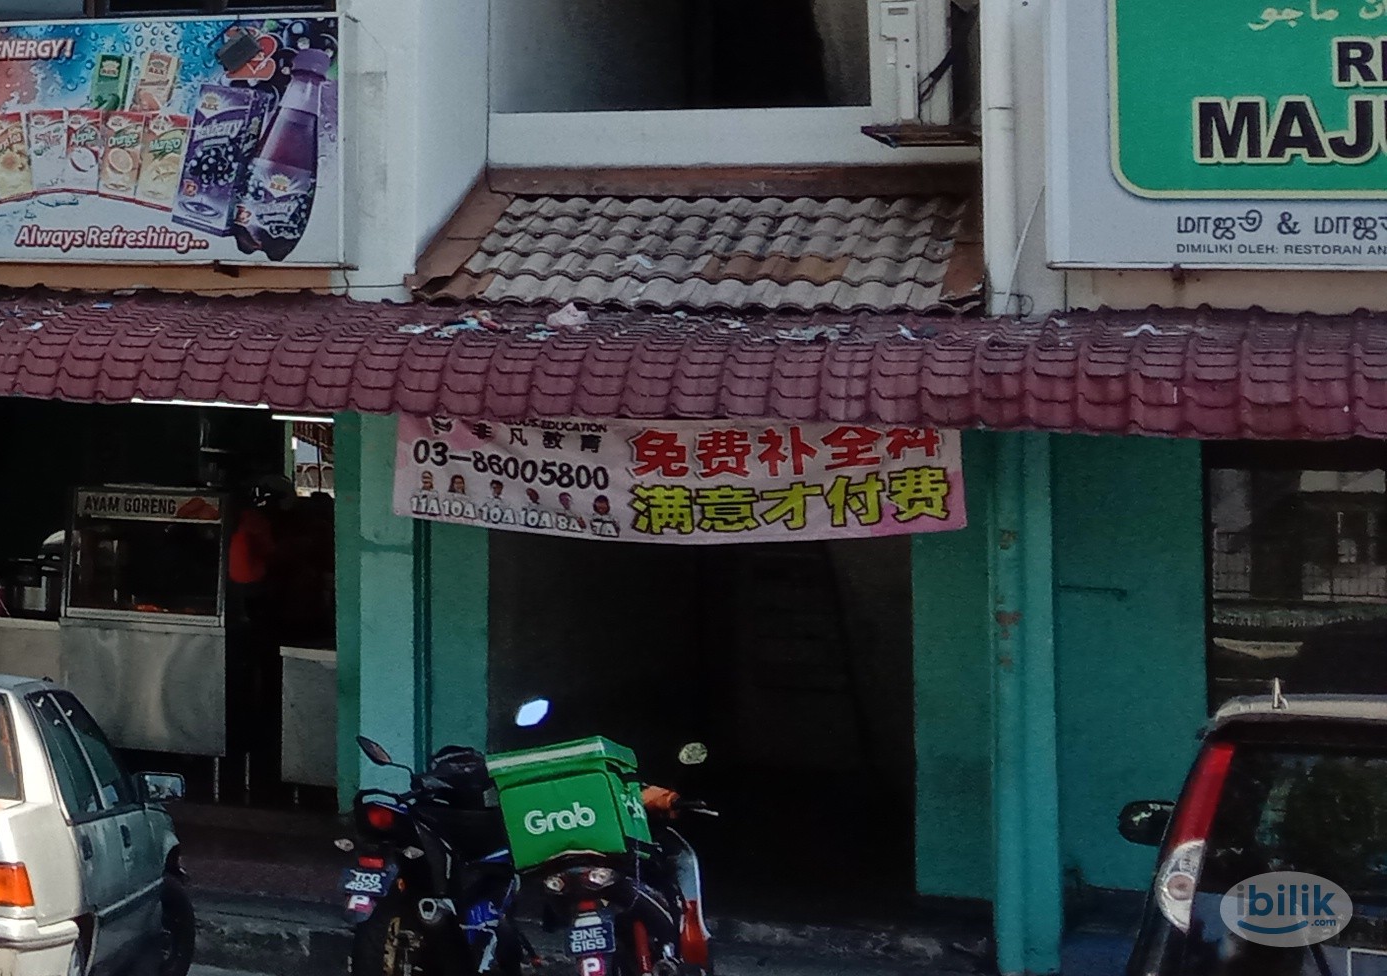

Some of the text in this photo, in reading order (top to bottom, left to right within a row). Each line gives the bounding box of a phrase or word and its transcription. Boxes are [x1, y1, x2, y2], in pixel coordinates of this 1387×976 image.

[1332, 37, 1387, 86] R
[1192, 95, 1387, 164] MAJ
[1276, 212, 1301, 235] &
[15, 225, 209, 253] Always Refreshing...
[1176, 243, 1233, 254] DIMILIKI
[1284, 244, 1362, 255] RESTORAN
[84, 495, 177, 515] AYAM GORENG
[631, 466, 949, 536] 满意才付费
[442, 498, 476, 520] 10A
[480, 505, 516, 525] 10A
[520, 511, 554, 530] 10A
[525, 802, 596, 835] Grab
[345, 881, 382, 893] 4822
[353, 872, 381, 883] TCG
[348, 895, 370, 910] P
[571, 927, 604, 942] BNE
[571, 938, 607, 954] 6169
[583, 957, 601, 976] P
